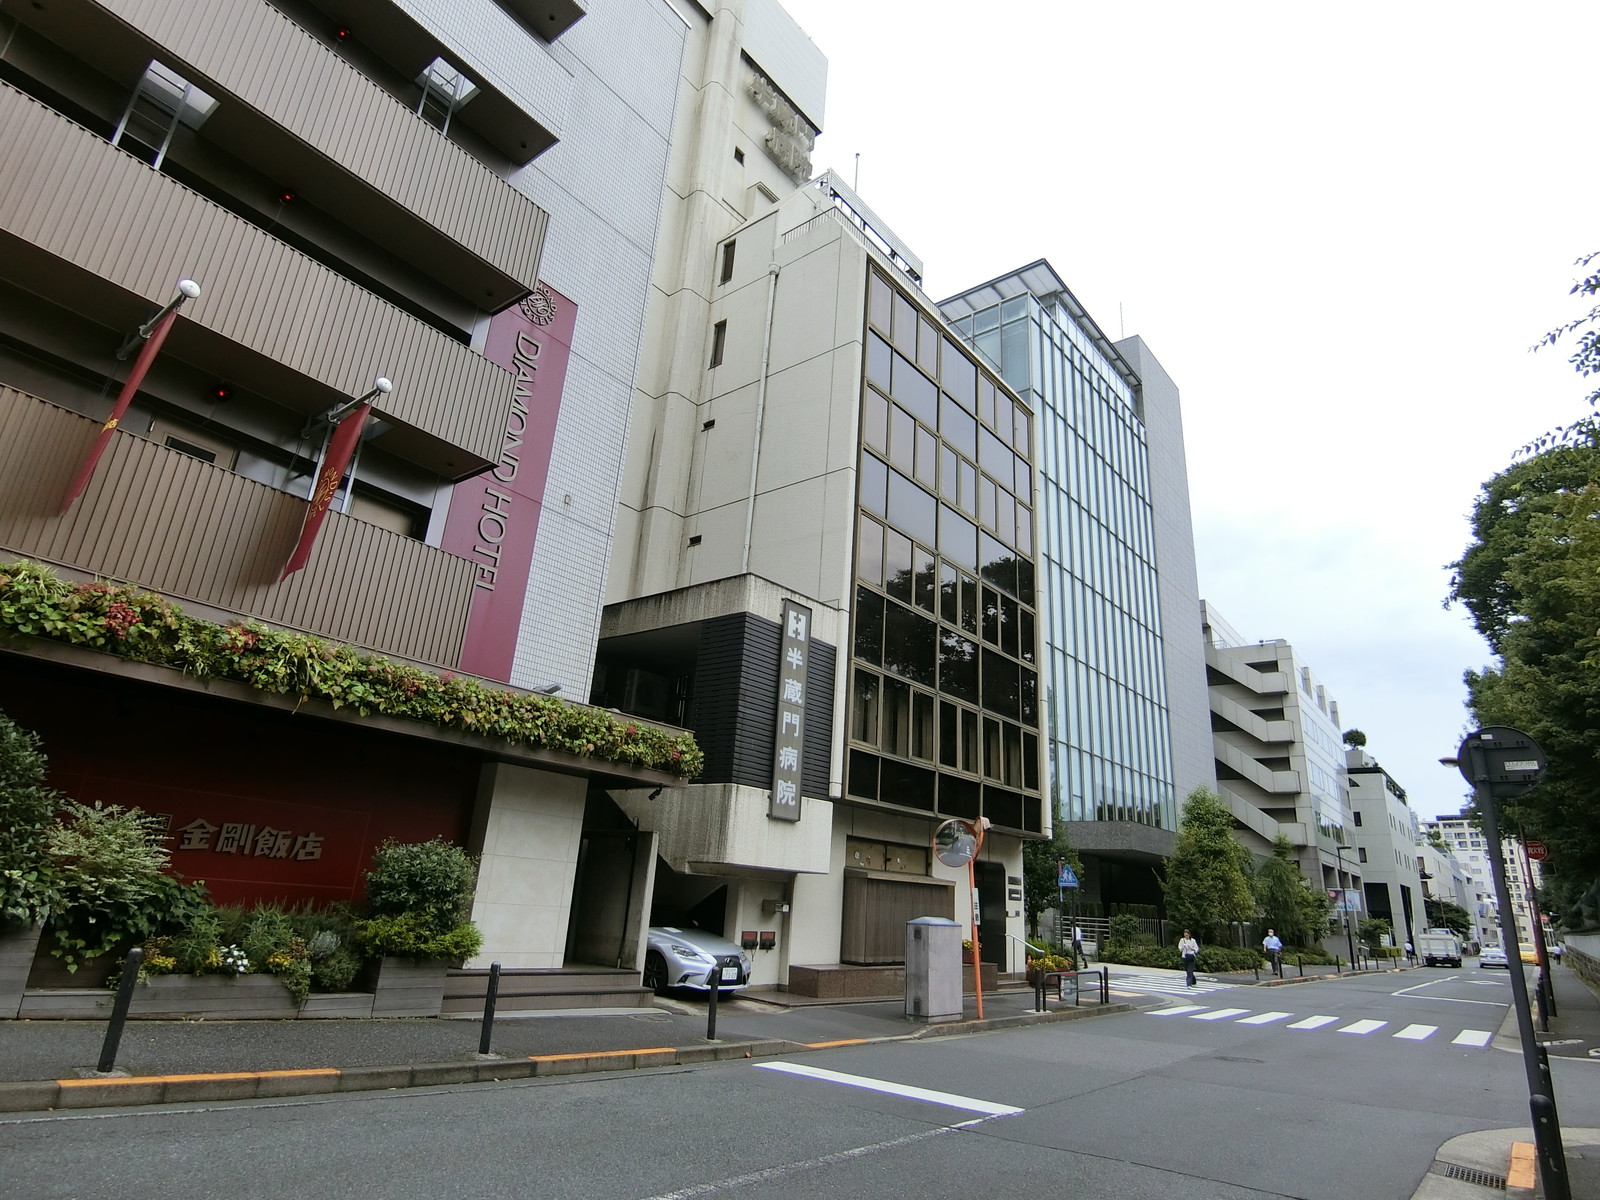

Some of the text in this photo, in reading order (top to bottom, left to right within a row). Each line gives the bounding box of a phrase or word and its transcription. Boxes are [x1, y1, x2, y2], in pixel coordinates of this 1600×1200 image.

[491, 330, 542, 483] DIAMOND
[776, 646, 803, 807] 半蔵門病院
[175, 817, 325, 861] 金剛飯店
